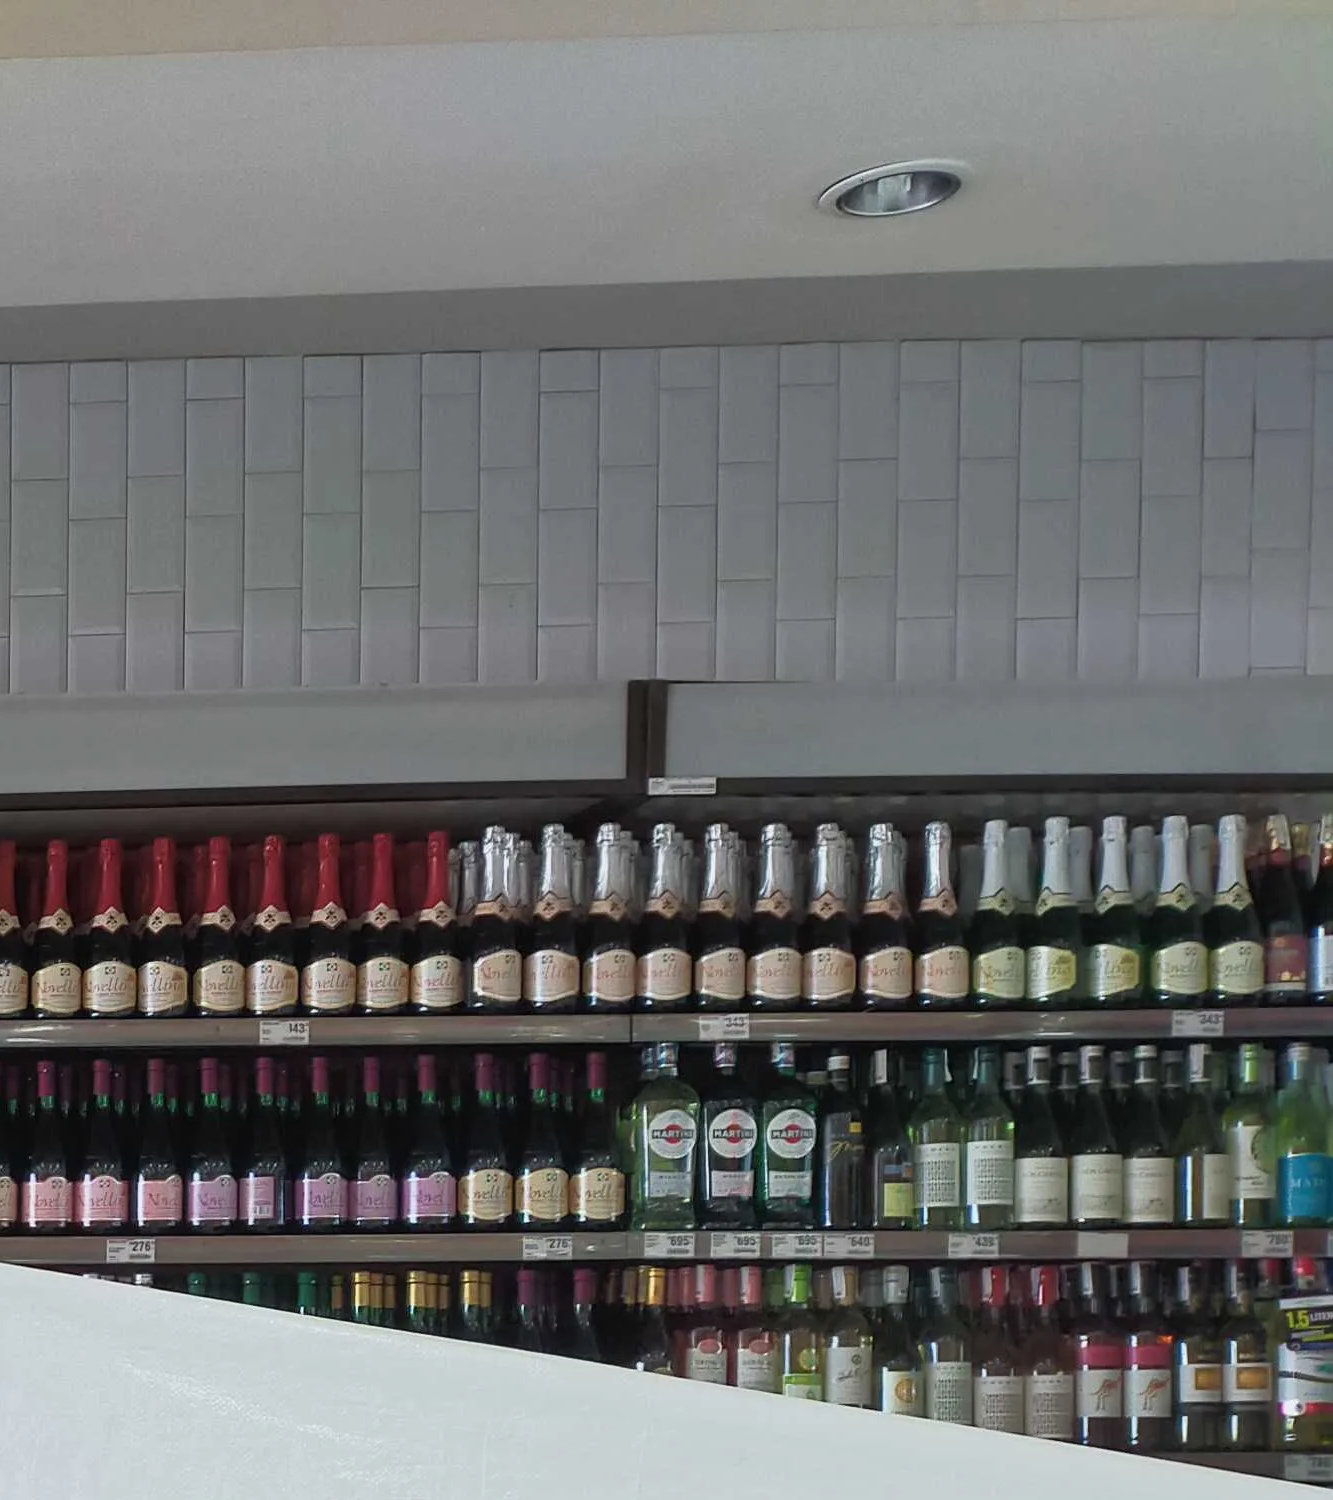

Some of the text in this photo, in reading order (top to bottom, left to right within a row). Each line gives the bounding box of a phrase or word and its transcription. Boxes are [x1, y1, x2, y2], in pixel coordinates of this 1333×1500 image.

[652, 1129, 694, 1139] MARTINI
[714, 1129, 754, 1139] MARTINI
[771, 1129, 813, 1139] MARTINI
[1286, 1311, 1310, 1329] 1.5
